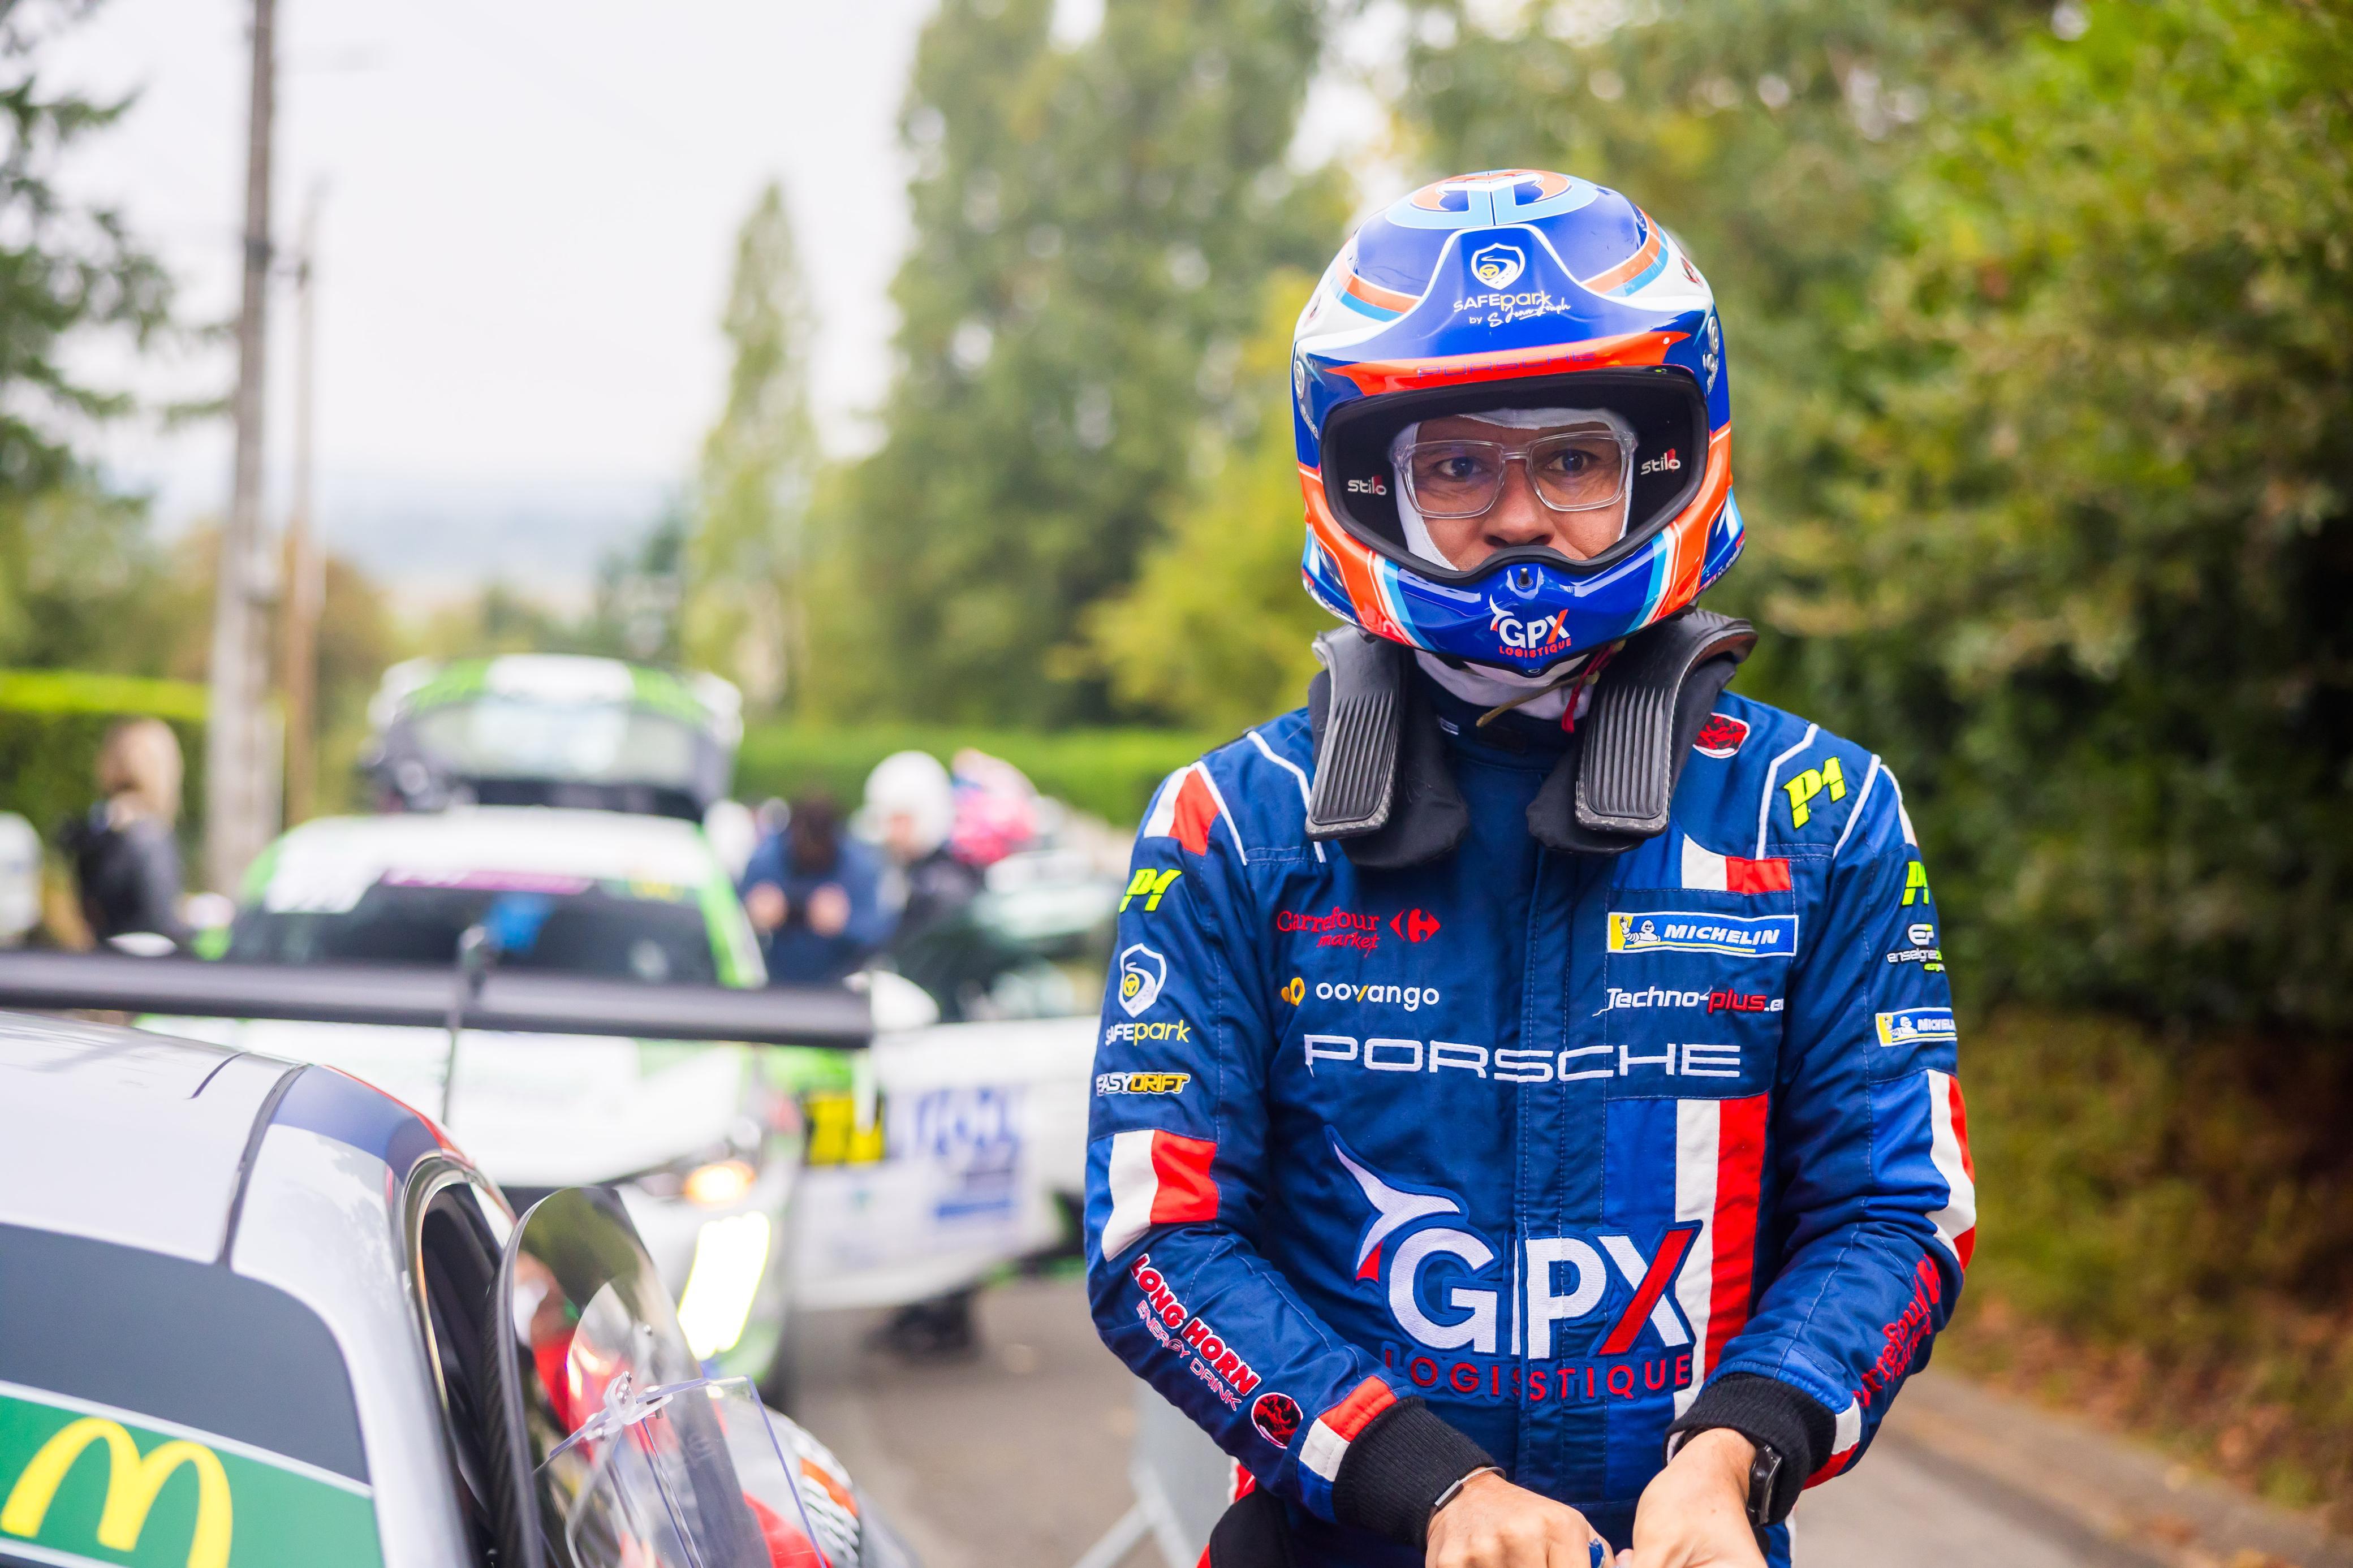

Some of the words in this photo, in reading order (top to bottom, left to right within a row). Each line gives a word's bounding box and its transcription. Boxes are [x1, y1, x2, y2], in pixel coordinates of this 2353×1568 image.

[1453, 290, 1553, 312] SAFEpark
[1468, 316, 1483, 325] by
[1417, 348, 1595, 380] PORSCHE
[1641, 452, 1681, 475] stilo
[1347, 477, 1387, 496] stilo
[1499, 608, 1570, 649] GPX
[1499, 638, 1571, 658] LOGISTIQUE
[1277, 906, 1380, 932] Carrefour
[1316, 931, 1380, 951] market
[1664, 924, 1781, 945] MICHELIN
[1606, 986, 1784, 1014] Techno-plus.e
[1304, 1034, 1741, 1083] PORSCHE
[1389, 1226, 1695, 1359] GPX
[1130, 1253, 1188, 1329] LONG
[1180, 1316, 1262, 1396] HORN
[1136, 1299, 1191, 1358] ENERGY
[1190, 1357, 1242, 1411] DRINK
